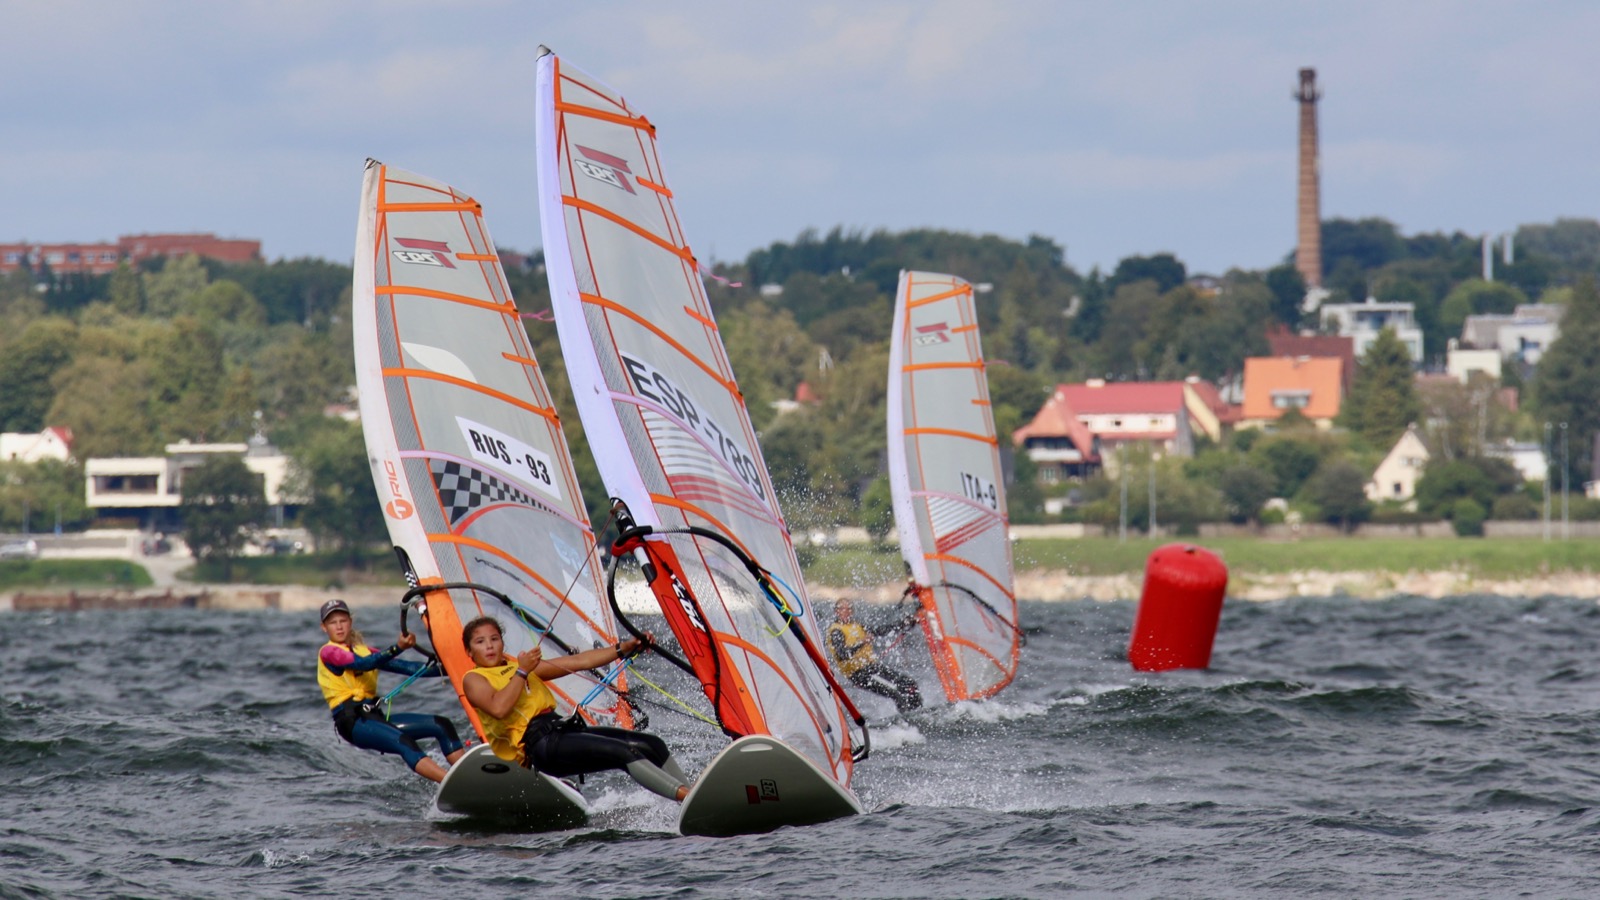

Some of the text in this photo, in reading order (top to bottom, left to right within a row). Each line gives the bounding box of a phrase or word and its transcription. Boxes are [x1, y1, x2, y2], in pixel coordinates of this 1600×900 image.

[468, 428, 512, 466] RUS
[525, 453, 552, 486] 93
[383, 460, 403, 498] RIG
[960, 471, 997, 510] ITA-9
